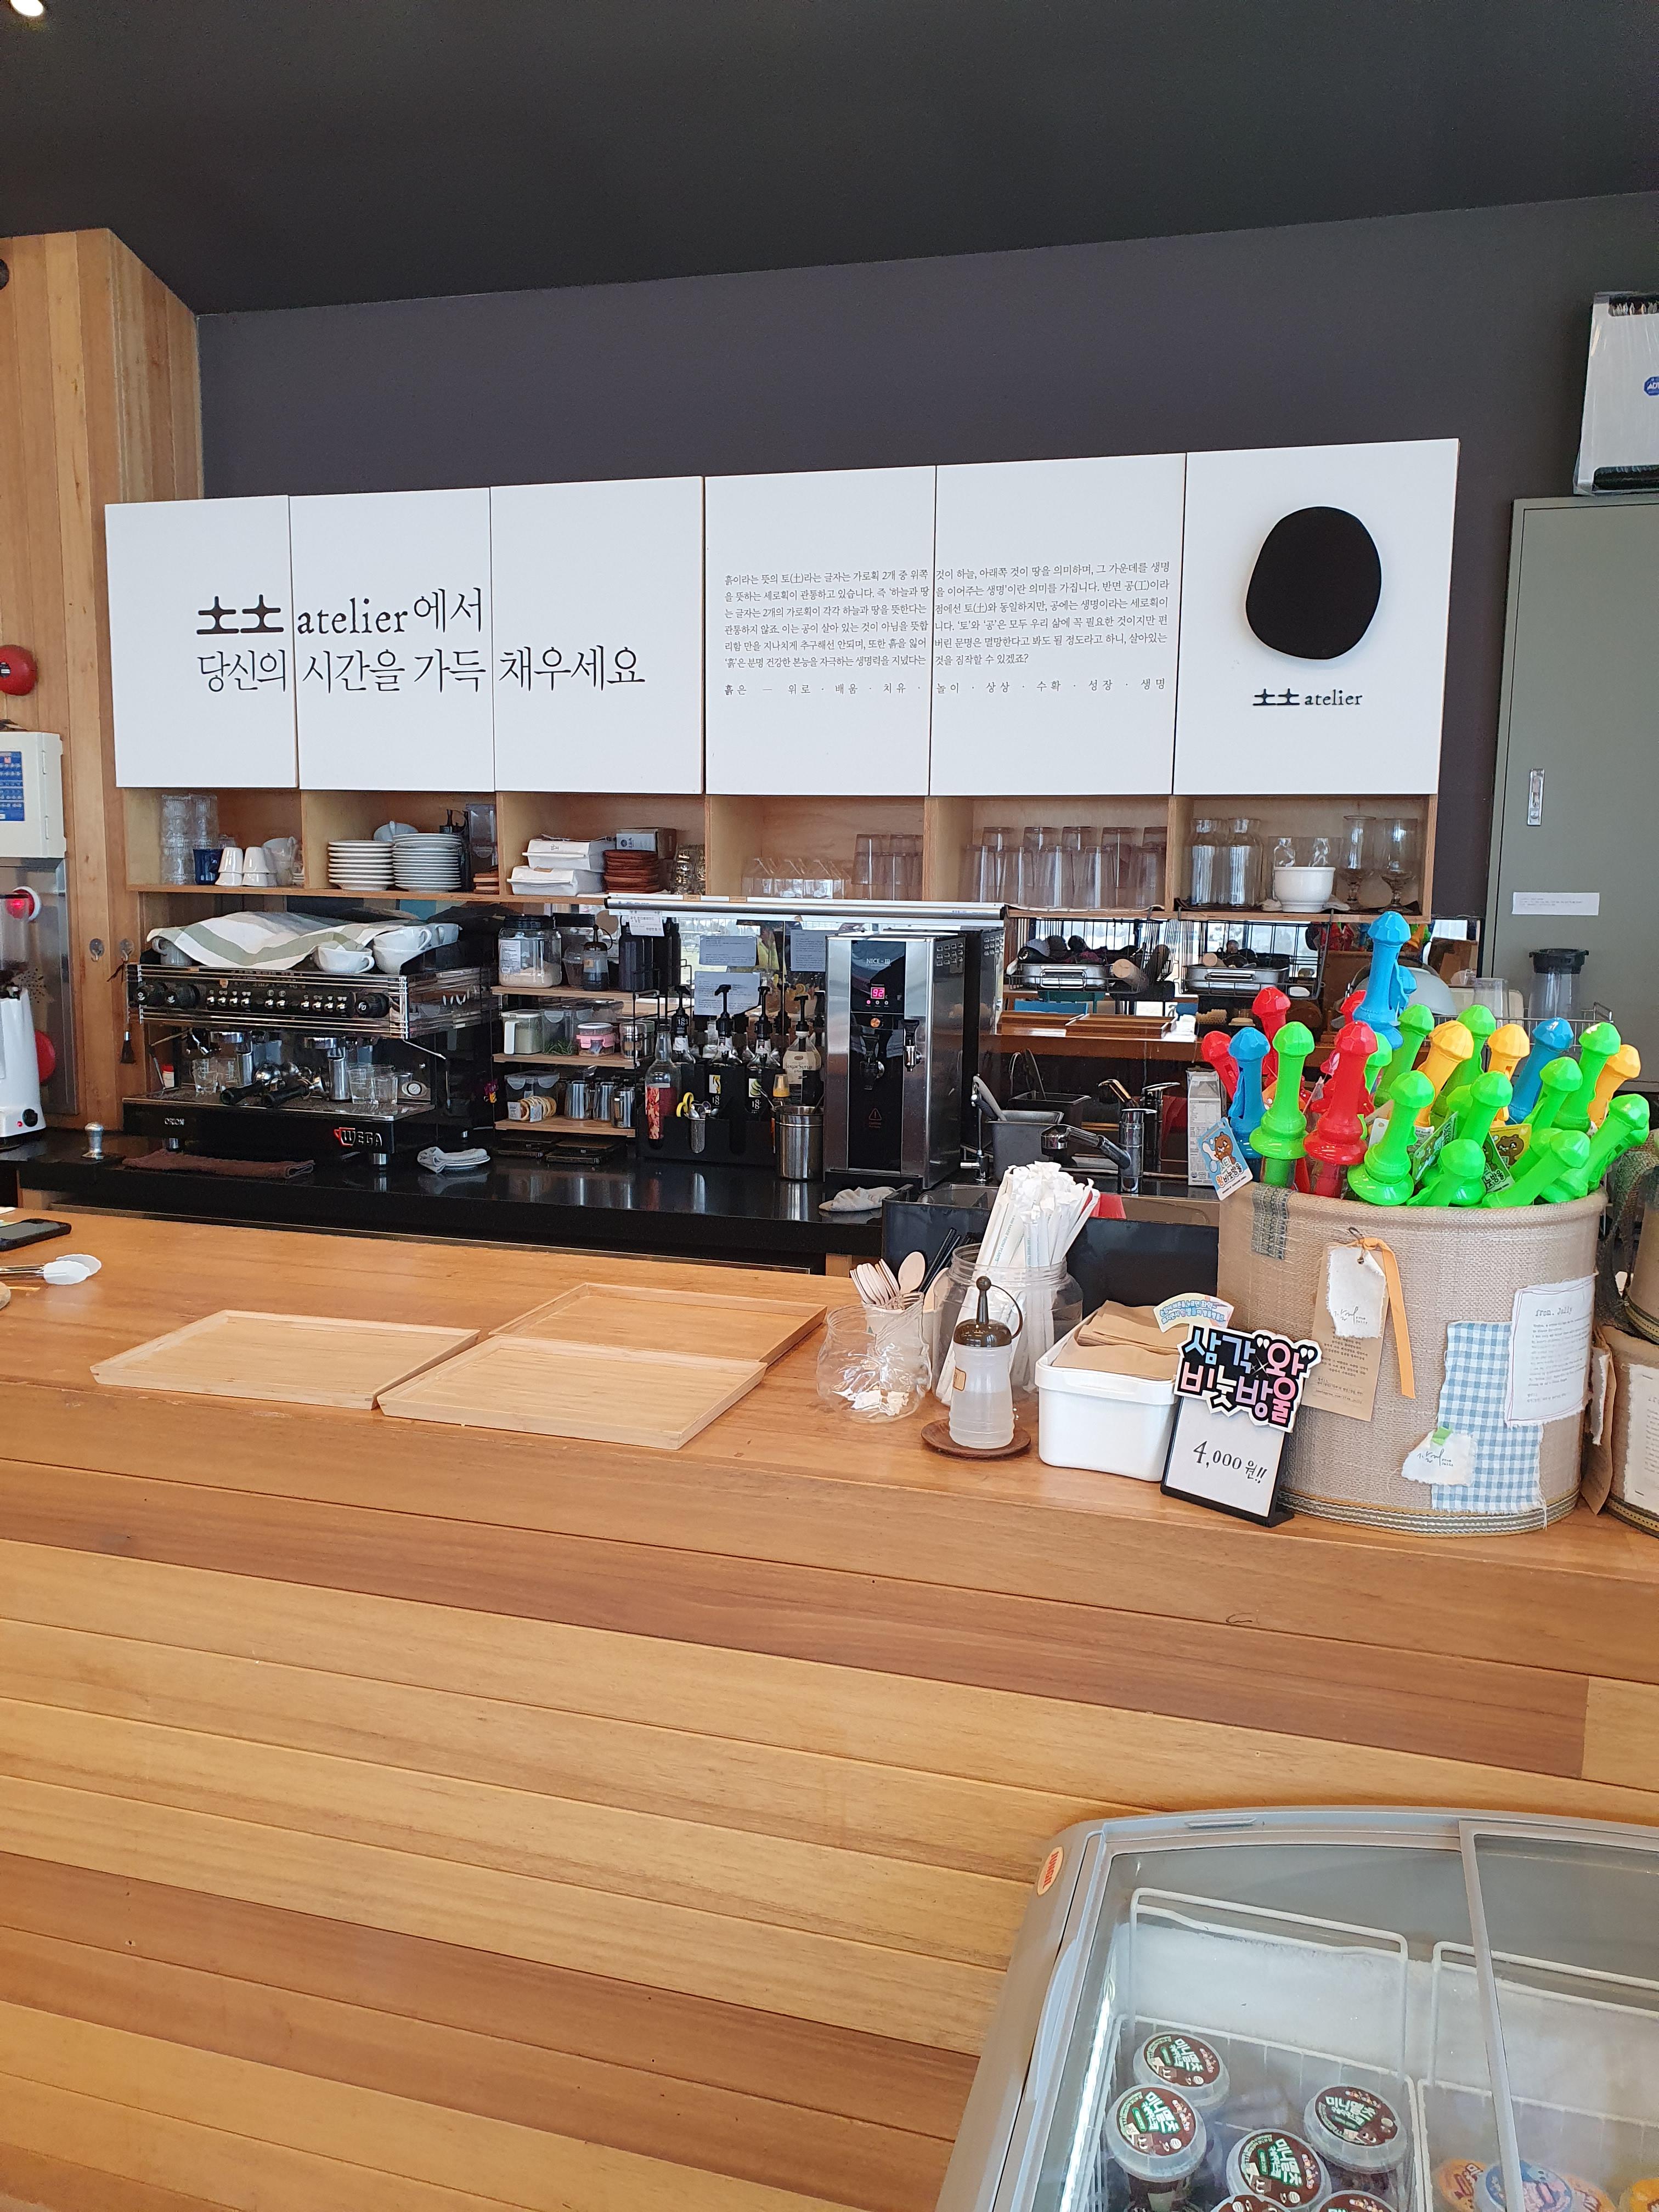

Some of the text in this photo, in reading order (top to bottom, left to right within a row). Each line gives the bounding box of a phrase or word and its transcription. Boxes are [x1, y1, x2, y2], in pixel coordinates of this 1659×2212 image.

[724, 574, 759, 586] 흙이라는
[761, 573, 778, 585] 뜻의
[823, 572, 851, 583] 글자는
[853, 570, 879, 582] 가로획
[882, 569, 895, 581] 2개
[898, 570, 908, 580] 중
[910, 569, 928, 580] 위쪽
[936, 568, 953, 580] 것이
[956, 568, 977, 580] 하늘,
[979, 567, 1008, 579] 아래쪽
[1010, 566, 1028, 578] 것이
[1031, 565, 1051, 577] 땅을
[1053, 564, 1093, 576] 의미하며,
[1096, 565, 1107, 573] 그
[1109, 562, 1148, 574] 가운데를
[1150, 561, 1170, 573] 생명
[735, 591, 762, 602] 뜻하는
[763, 590, 797, 601] 세로획이
[800, 589, 836, 600] 관통하고
[838, 588, 874, 599] 있습니다.
[876, 588, 887, 599] 즉
[947, 585, 985, 597] 이어주는
[1029, 583, 1057, 595] 의미를
[1059, 581, 1100, 594] 가집니다.
[1102, 580, 1121, 592] 반면
[724, 608, 733, 619] 는
[735, 608, 761, 619] 글자는
[763, 607, 783, 618] 2개의
[786, 606, 820, 618] 가로획이
[823, 606, 841, 617] 각각
[842, 605, 870, 617] 하늘과
[871, 604, 889, 616] 땅을
[890, 603, 927, 615] 뜻한다는
[934, 600, 962, 615] 점에선
[999, 600, 1047, 613] 동일하지만,
[1049, 600, 1079, 611] 공에는
[1080, 598, 1128, 611] 생명이라는
[1130, 596, 1168, 609] 세로획이
[724, 624, 758, 635] 관통하지
[782, 623, 800, 634] 이는
[801, 623, 818, 634] 공이
[821, 622, 839, 634] 살아
[841, 622, 860, 633] 있는
[861, 621, 878, 633] 것이
[881, 620, 909, 633] 아님을
[1009, 619, 1028, 630] 모두
[1030, 618, 1048, 629] 우리
[1051, 617, 1070, 629] 삶에
[1073, 617, 1084, 628] 꼭
[1086, 616, 1114, 628] 필요한
[1117, 614, 1156, 627] 것이지만
[764, 640, 798, 651] 지나치게
[800, 639, 835, 651] 추구해선
[837, 639, 866, 651] 안되며,
[867, 638, 887, 649] 또한
[888, 637, 907, 649] 흙을
[909, 637, 926, 648] 잃어
[934, 637, 952, 649] 버린
[955, 637, 982, 648] 문명은
[984, 636, 1030, 648] 멸망한다고
[1032, 635, 1051, 647] 봐도
[1053, 635, 1062, 646] 될
[1065, 634, 1103, 646] 정도라고
[1105, 633, 1126, 645] 하니,
[1128, 632, 1168, 644] 살아있는
[197, 645, 646, 694] 당신의 시간을 가득 채우세요
[747, 657, 764, 668] 분명
[766, 657, 791, 668] 건강한
[792, 657, 819, 668] 본능을
[820, 656, 854, 667] 자극하는
[855, 655, 890, 667] 생명력을
[891, 654, 927, 666] 지녔다는
[935, 655, 953, 666] 것을
[956, 654, 983, 665] 짐작할
[984, 654, 995, 665] 수
[997, 653, 1029, 664] 있겠죠?
[1304, 689, 1363, 706] atelier
[872, 989, 884, 997] 92
[341, 1129, 382, 1147] WEGA
[1485, 1169, 1505, 1187] 눗방울
[1181, 1362, 1296, 1424] 비눗방울
